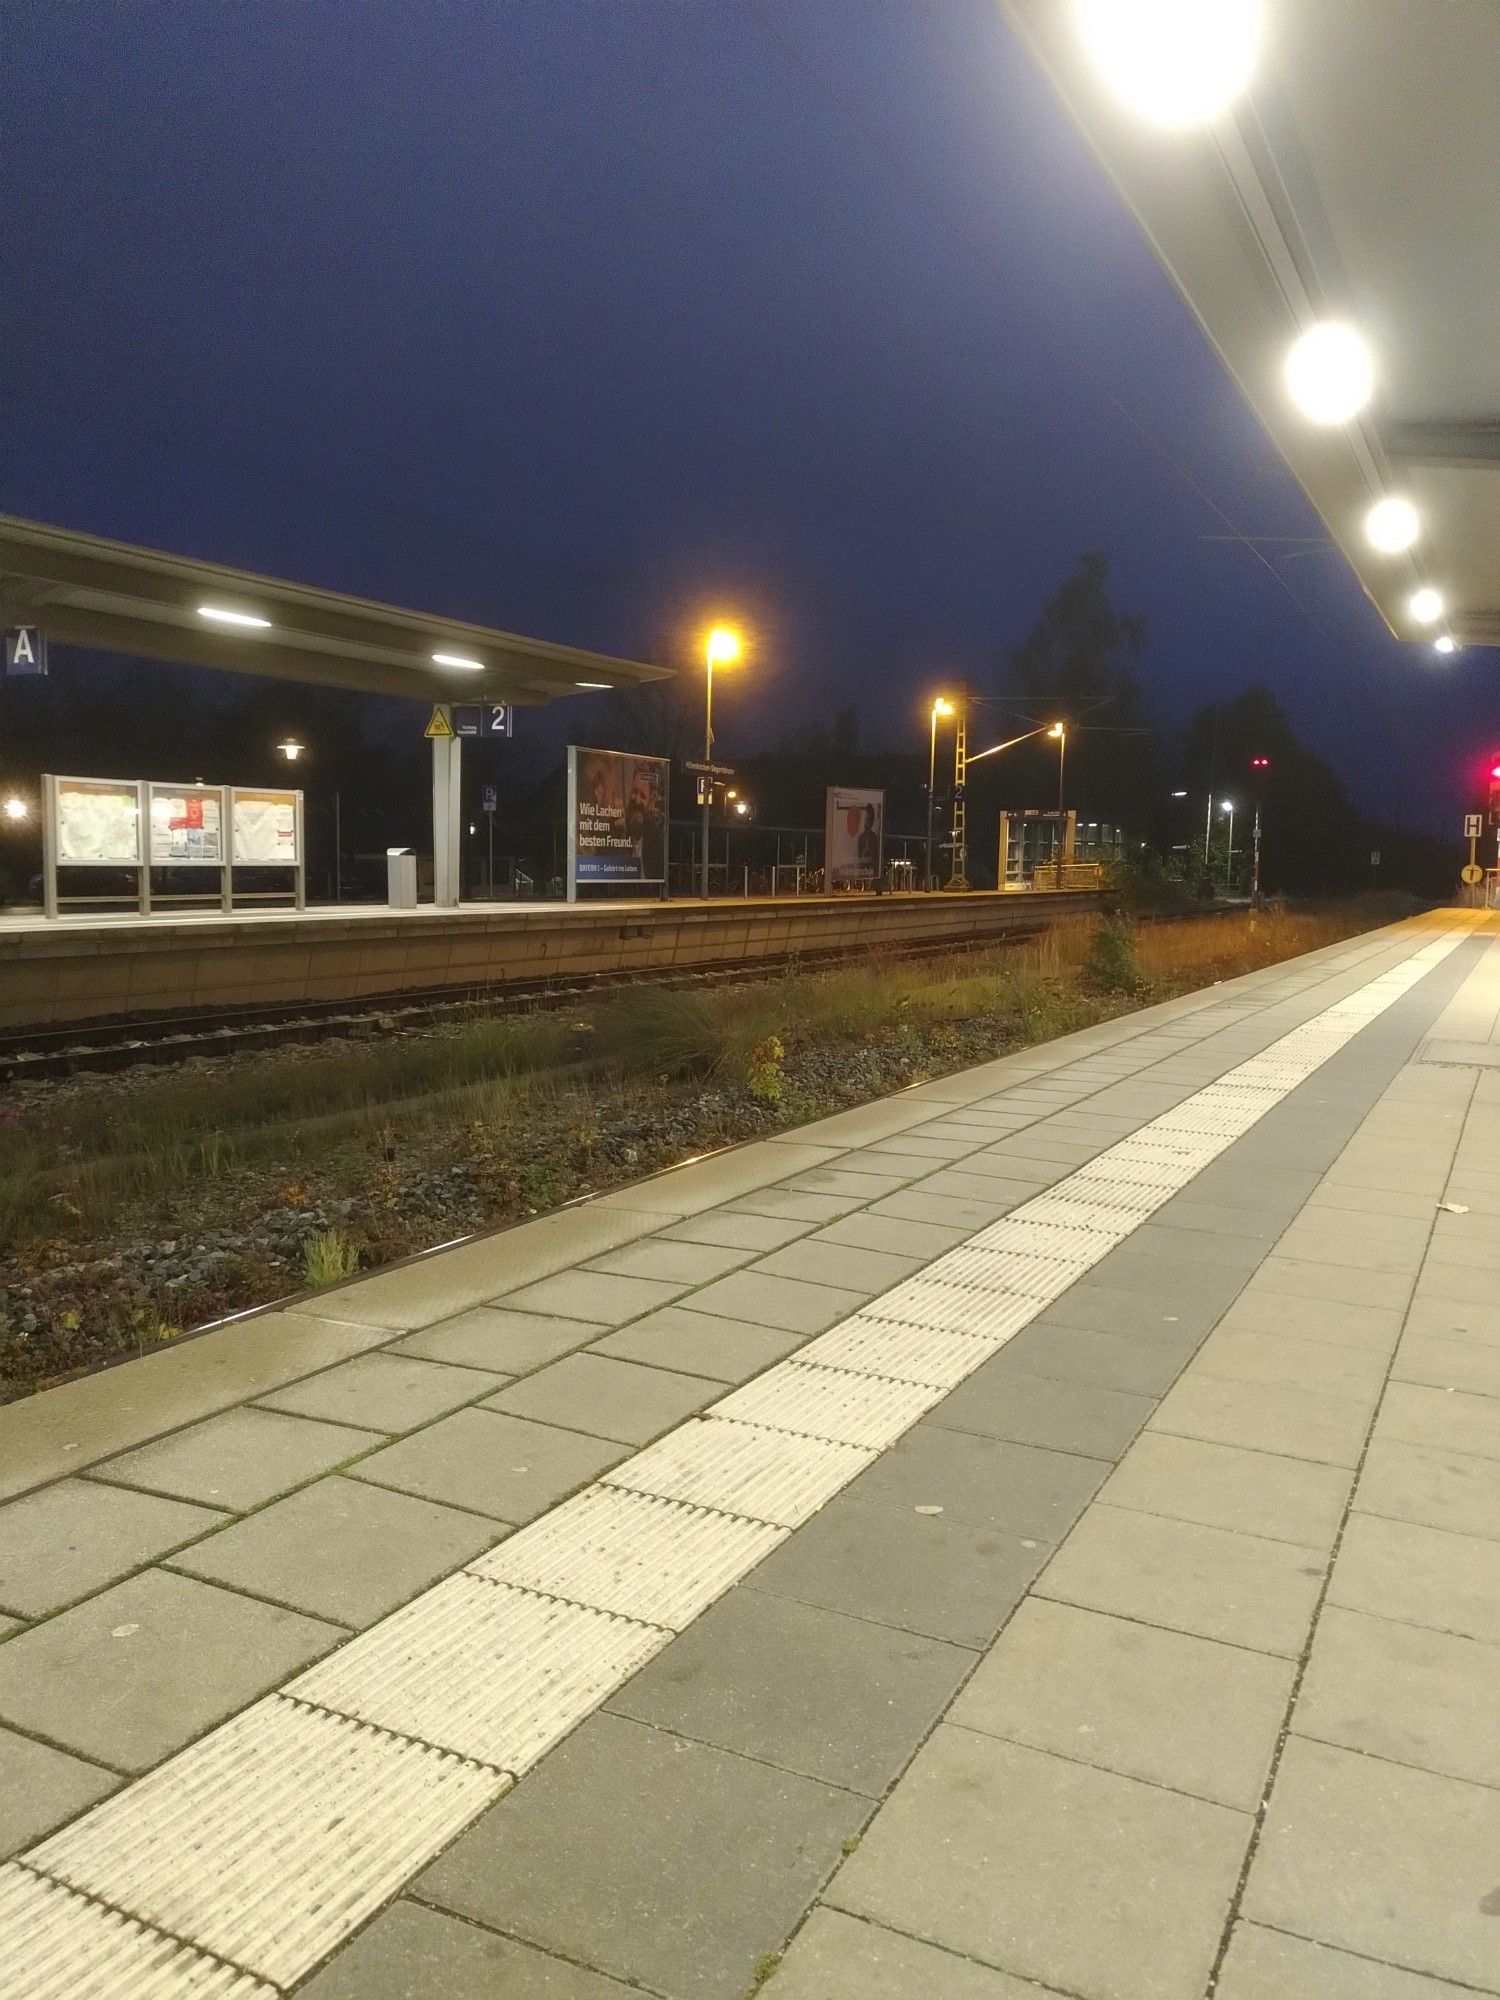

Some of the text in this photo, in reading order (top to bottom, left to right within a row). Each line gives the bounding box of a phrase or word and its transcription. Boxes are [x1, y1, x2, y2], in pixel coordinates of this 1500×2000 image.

[13, 629, 35, 664] A
[491, 706, 505, 730] 2
[485, 787, 494, 799] P
[954, 785, 963, 799] 2
[579, 802, 622, 818] Wie Lachen
[579, 818, 610, 832] mit dem
[1467, 817, 1480, 835] H
[579, 834, 633, 848] besten Freund.
[1467, 867, 1477, 881] T
